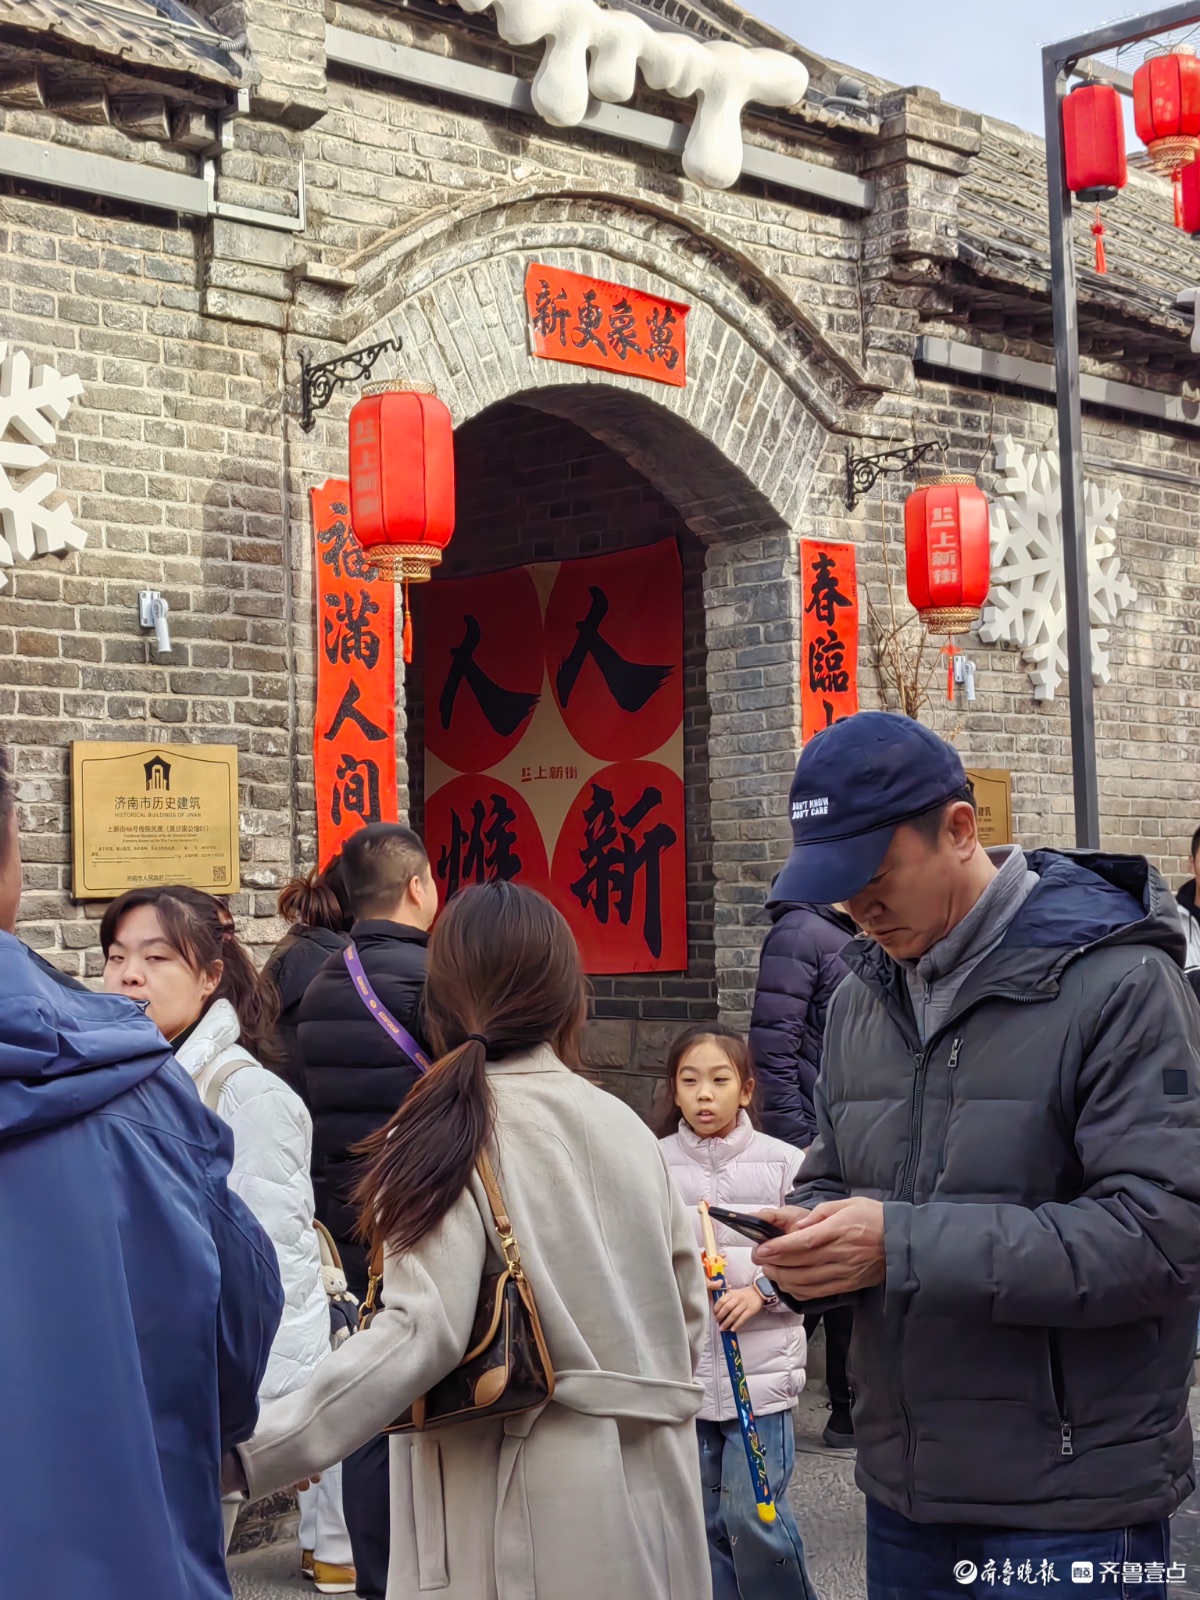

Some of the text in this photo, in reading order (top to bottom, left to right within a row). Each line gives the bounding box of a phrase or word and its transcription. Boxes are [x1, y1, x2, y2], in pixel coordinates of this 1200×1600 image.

[114, 796, 201, 810] 济南市历史建筑
[810, 797, 829, 809] KNOW
[811, 806, 829, 816] CARE
